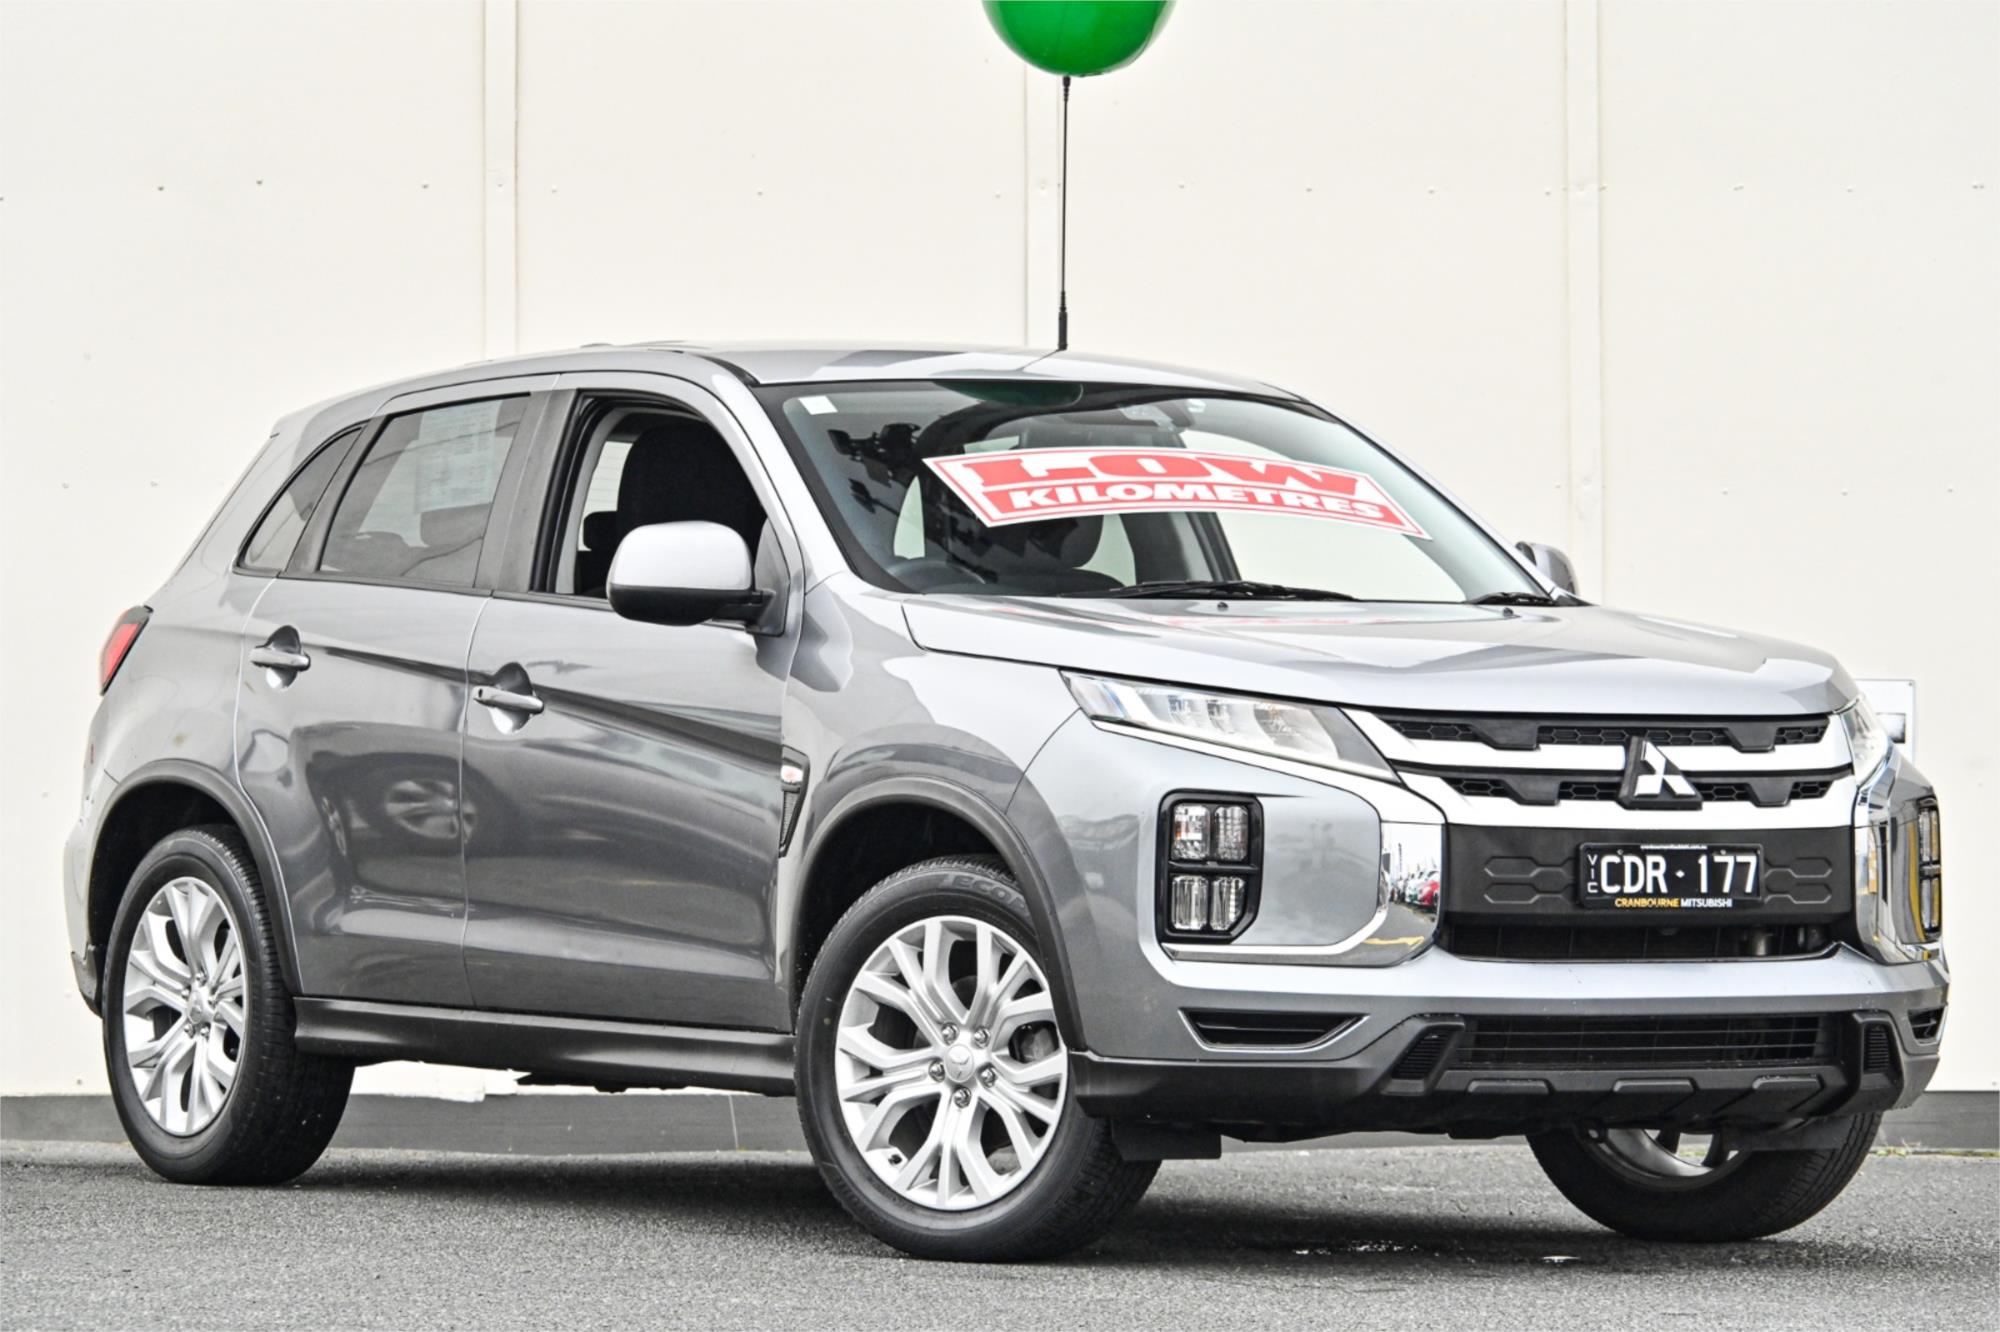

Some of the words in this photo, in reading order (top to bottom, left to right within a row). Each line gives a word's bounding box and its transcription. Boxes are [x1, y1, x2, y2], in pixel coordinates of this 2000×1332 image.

[962, 455, 1357, 495] LOW
[1008, 481, 1384, 518] KILOMETRES
[1587, 854, 1598, 893] VIC
[1601, 854, 1668, 893] CDR
[1698, 854, 1757, 893] 177
[1615, 898, 1680, 907] CRANBOURNE
[1681, 898, 1732, 907] MITSUBISHI
